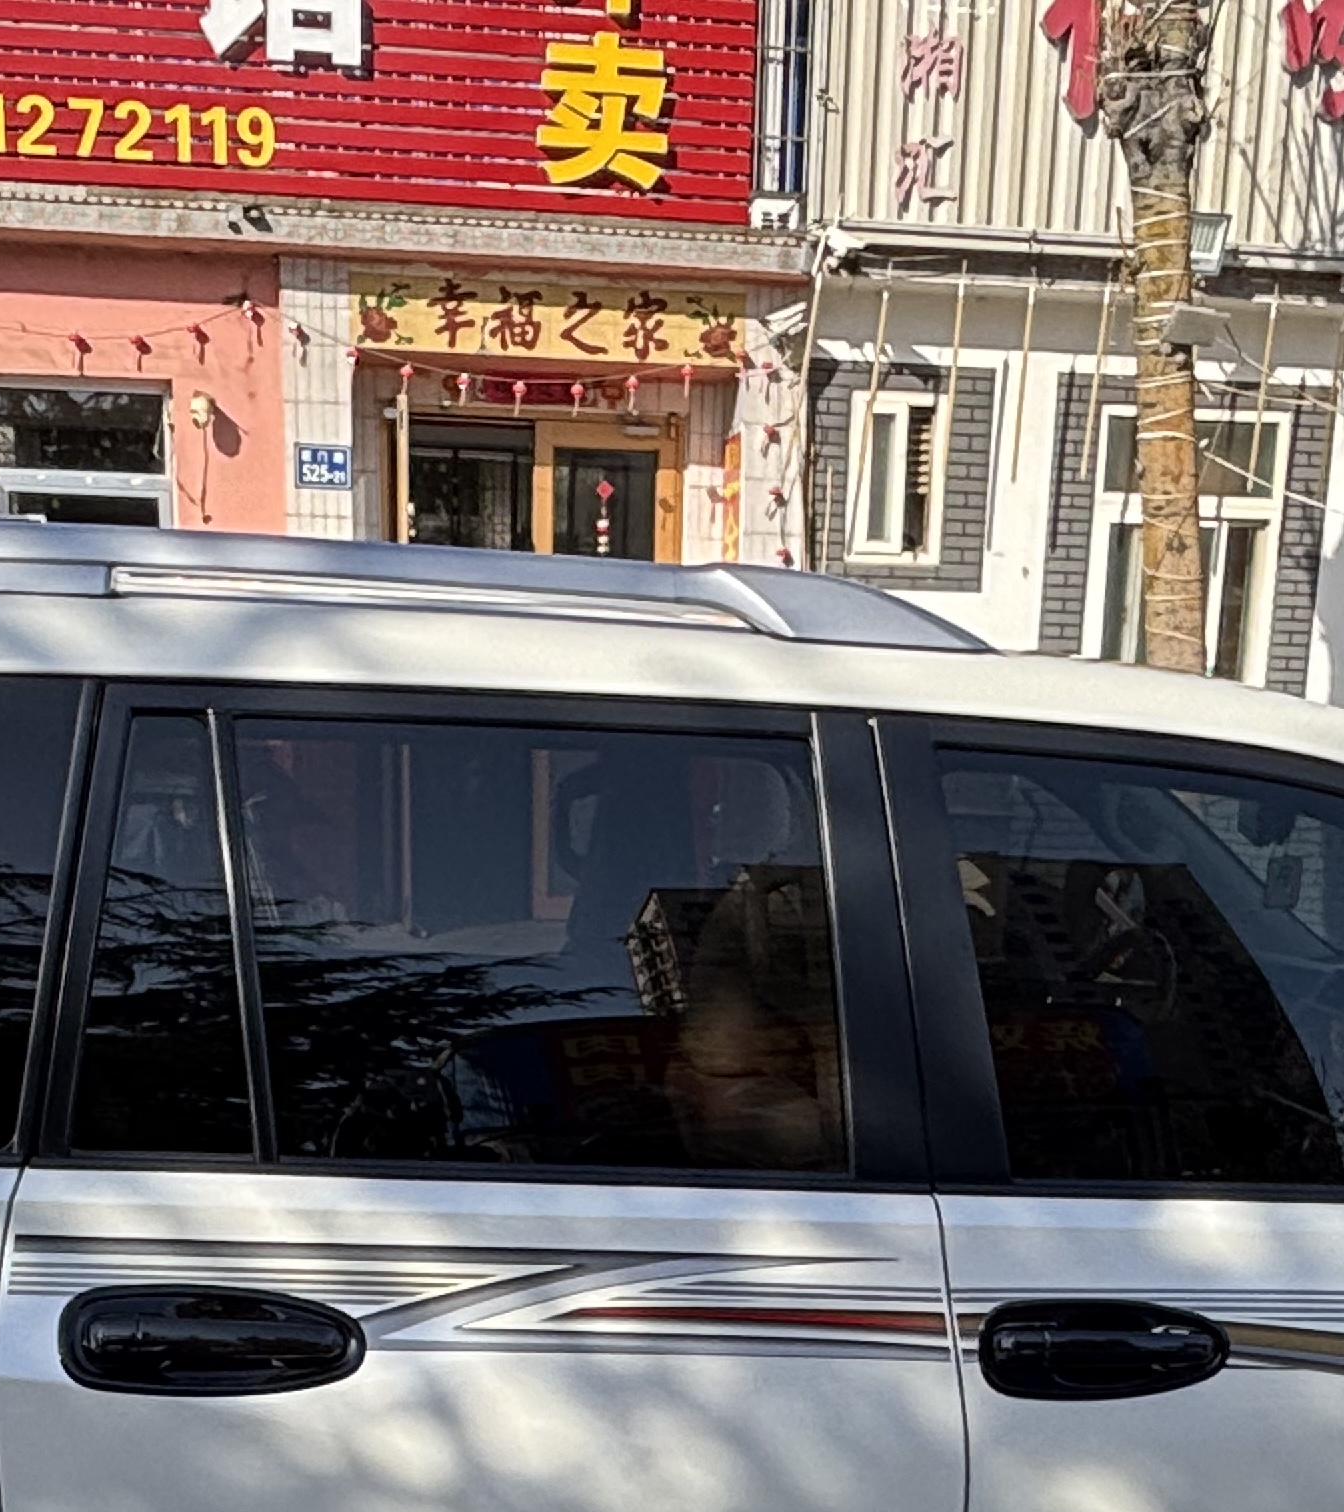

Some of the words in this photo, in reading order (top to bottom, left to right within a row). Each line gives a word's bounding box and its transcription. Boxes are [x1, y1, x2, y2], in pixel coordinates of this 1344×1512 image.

[536, 0, 668, 190] 卖
[427, 278, 670, 360] 幸福之家
